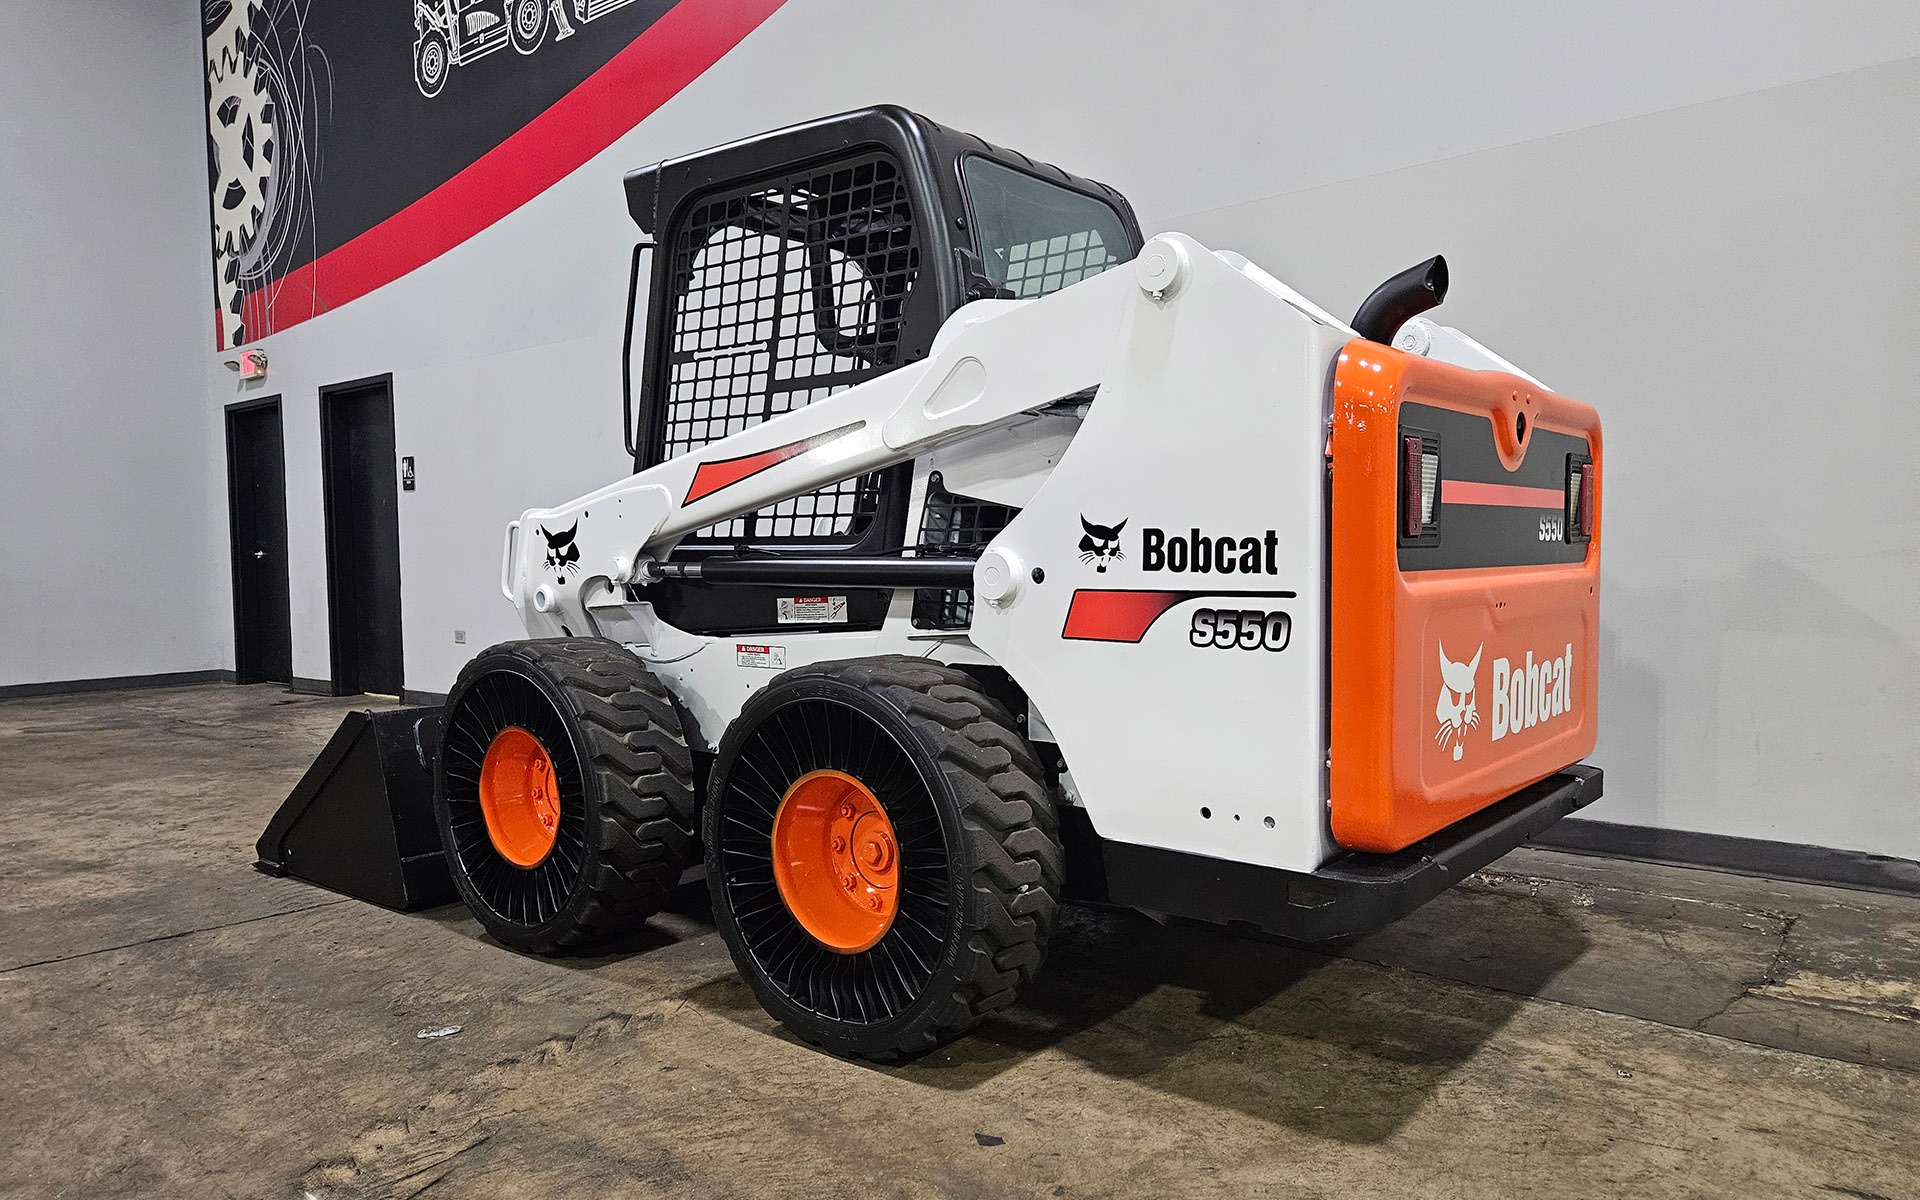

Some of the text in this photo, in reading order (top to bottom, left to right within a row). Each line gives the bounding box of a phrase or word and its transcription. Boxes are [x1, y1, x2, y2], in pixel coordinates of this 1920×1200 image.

[1538, 514, 1563, 541] S550
[1142, 528, 1278, 575] Bobcat
[1190, 608, 1292, 652] S550
[1491, 643, 1573, 742] Bobcat
